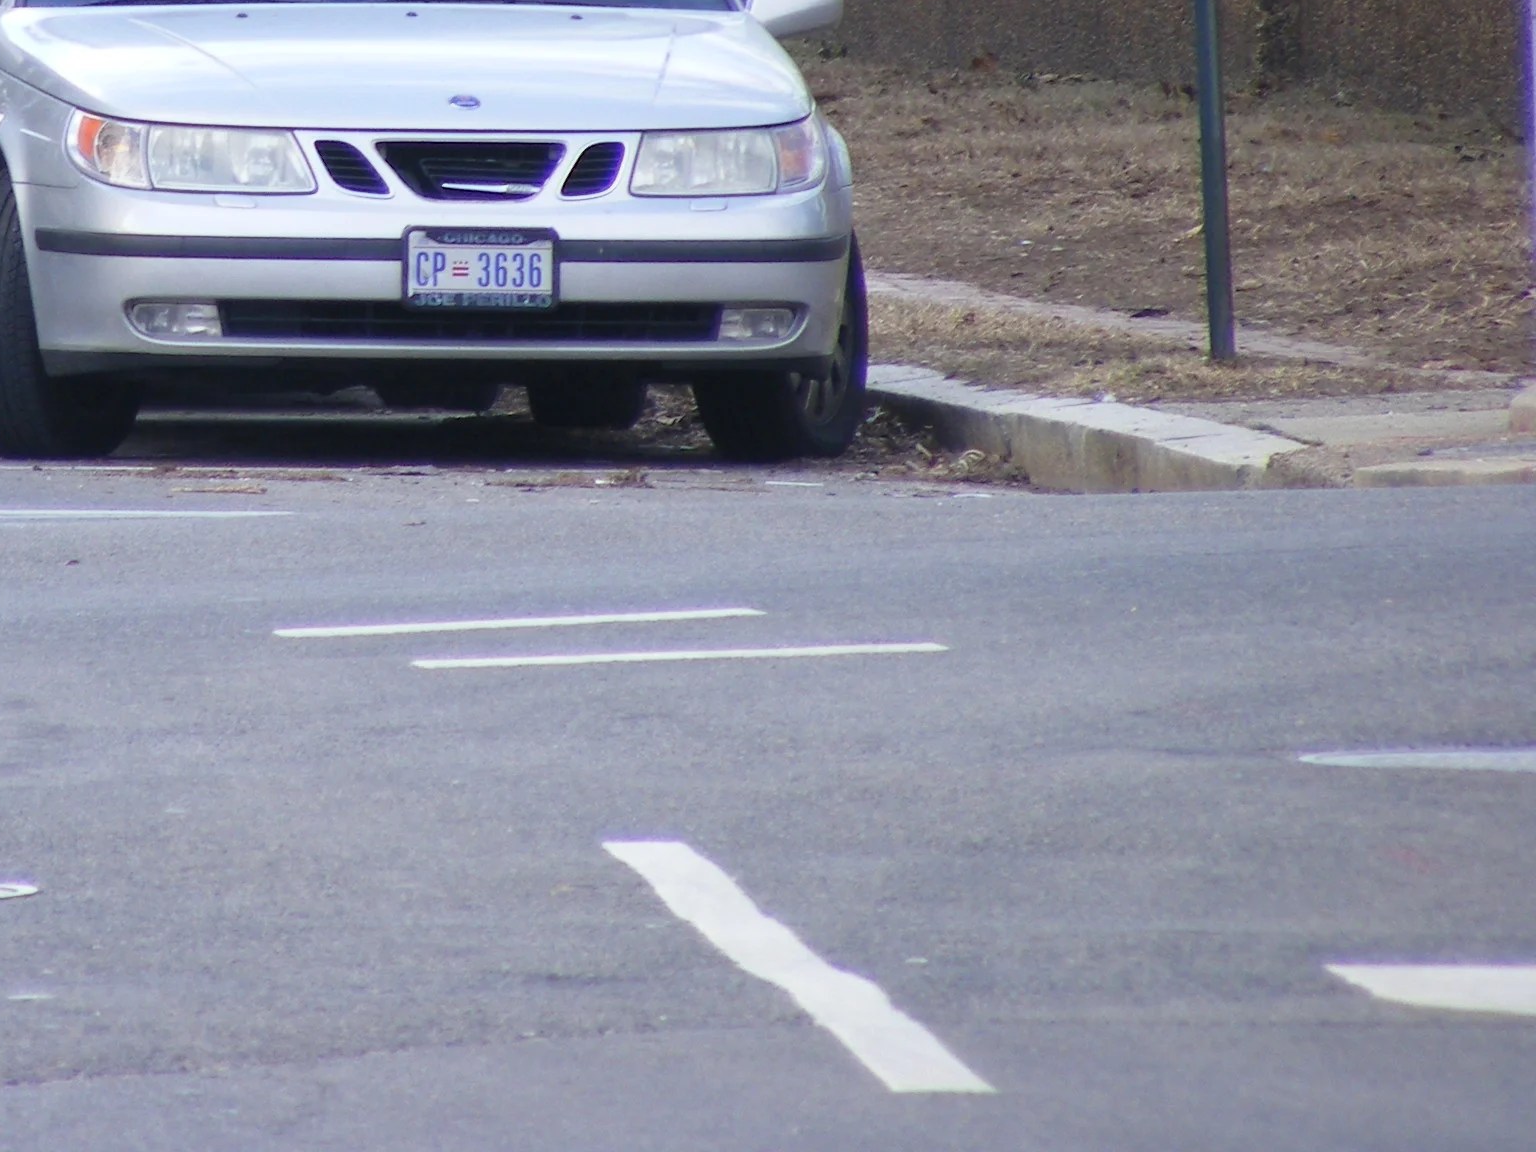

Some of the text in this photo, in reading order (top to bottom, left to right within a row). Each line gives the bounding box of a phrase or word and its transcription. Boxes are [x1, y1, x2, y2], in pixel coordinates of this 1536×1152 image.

[443, 232, 524, 244] CHICAGO
[416, 251, 542, 288] CP 3636
